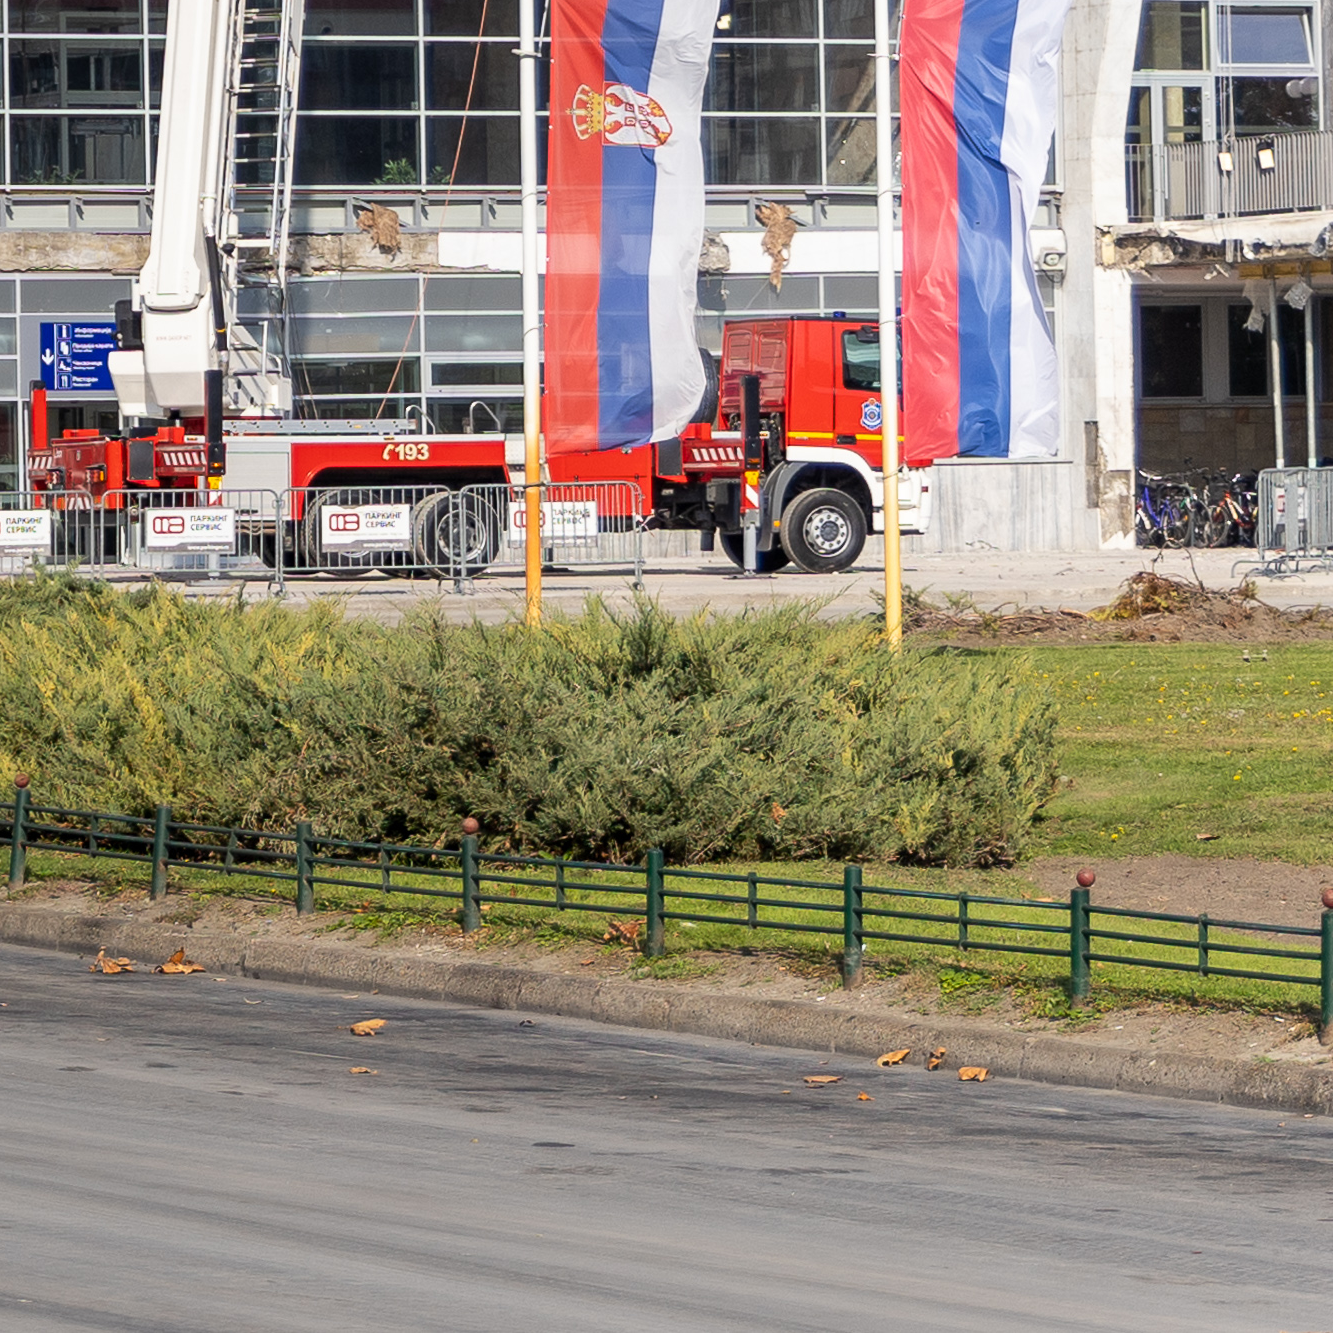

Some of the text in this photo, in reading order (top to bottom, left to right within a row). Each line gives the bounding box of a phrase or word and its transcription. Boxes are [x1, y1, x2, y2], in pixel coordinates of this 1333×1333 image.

[395, 443, 430, 461] 193
[365, 512, 402, 520] ПАРКИНГ
[5, 517, 43, 525] ПАРКИНГ
[190, 523, 222, 531] СЕРВИС
